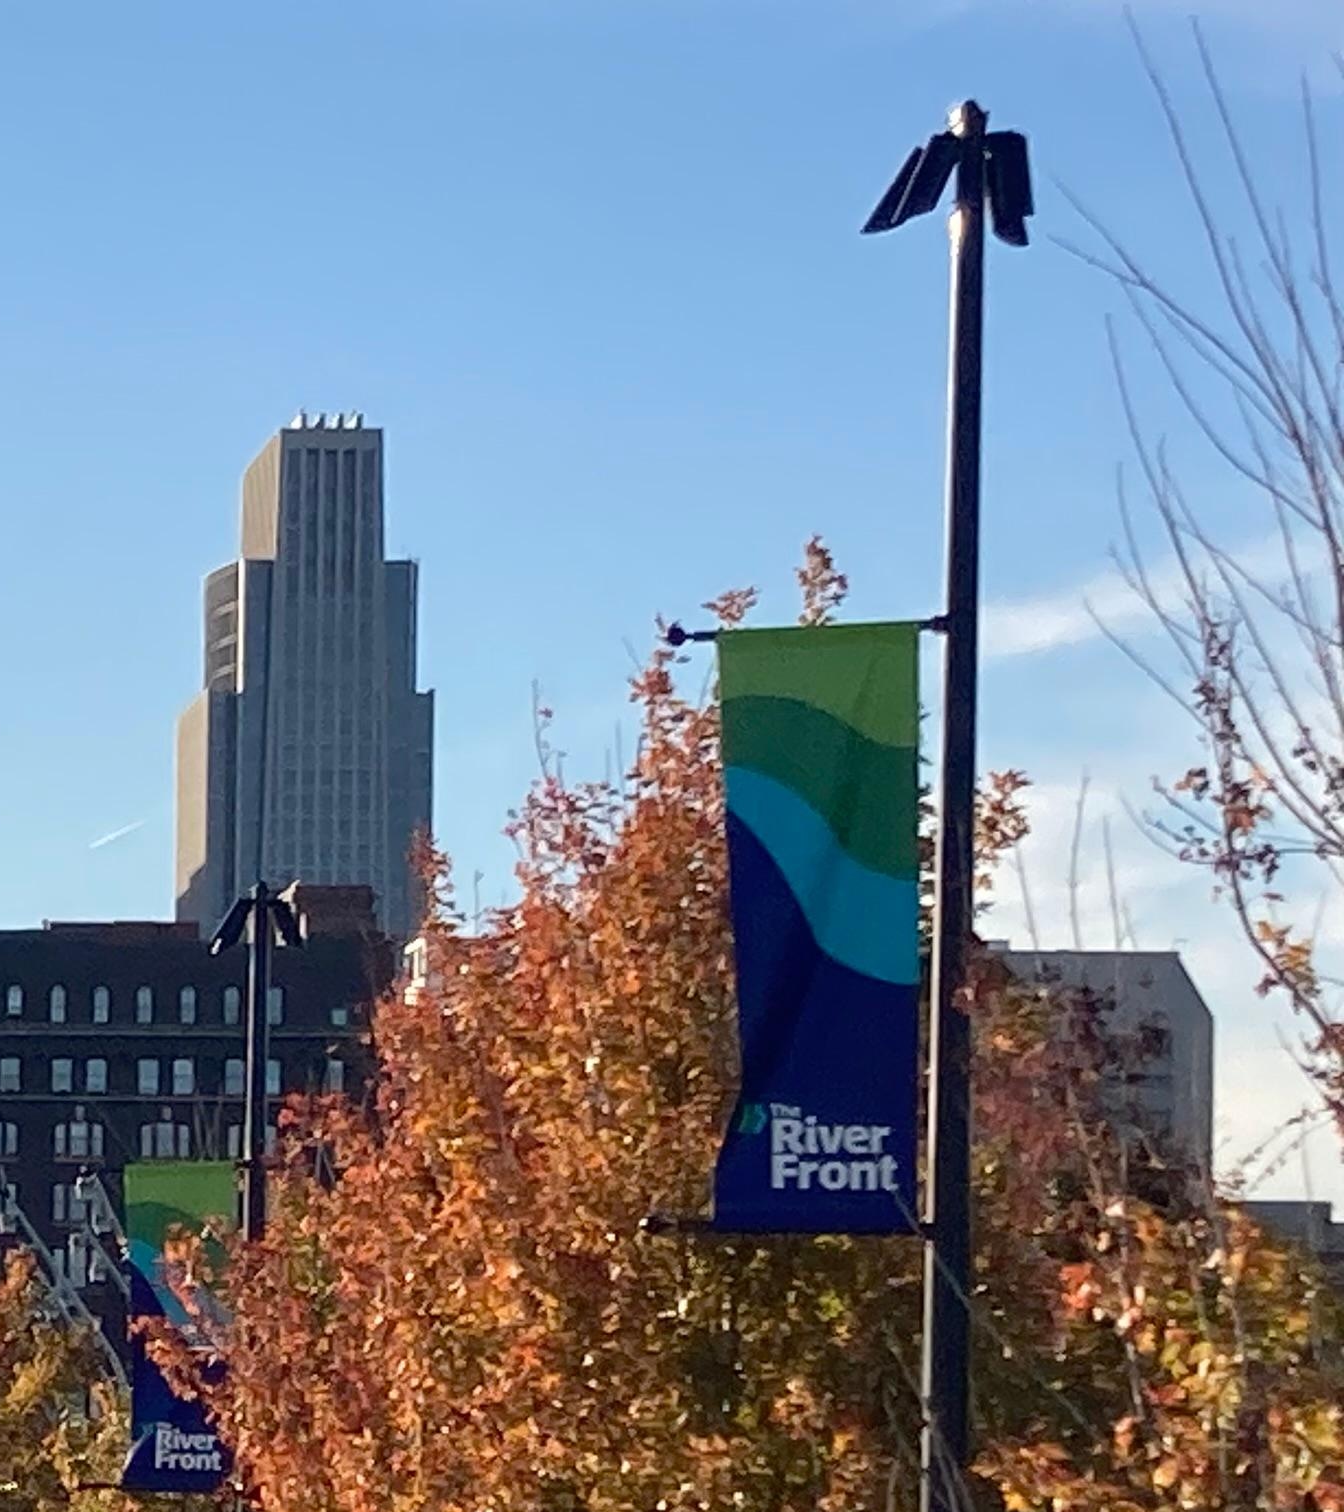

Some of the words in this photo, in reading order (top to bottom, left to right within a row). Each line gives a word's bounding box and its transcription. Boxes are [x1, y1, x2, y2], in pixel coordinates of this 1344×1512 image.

[770, 1115, 892, 1154] River
[770, 1154, 900, 1191] Front
[156, 1427, 218, 1451] River
[155, 1450, 223, 1471] Front
